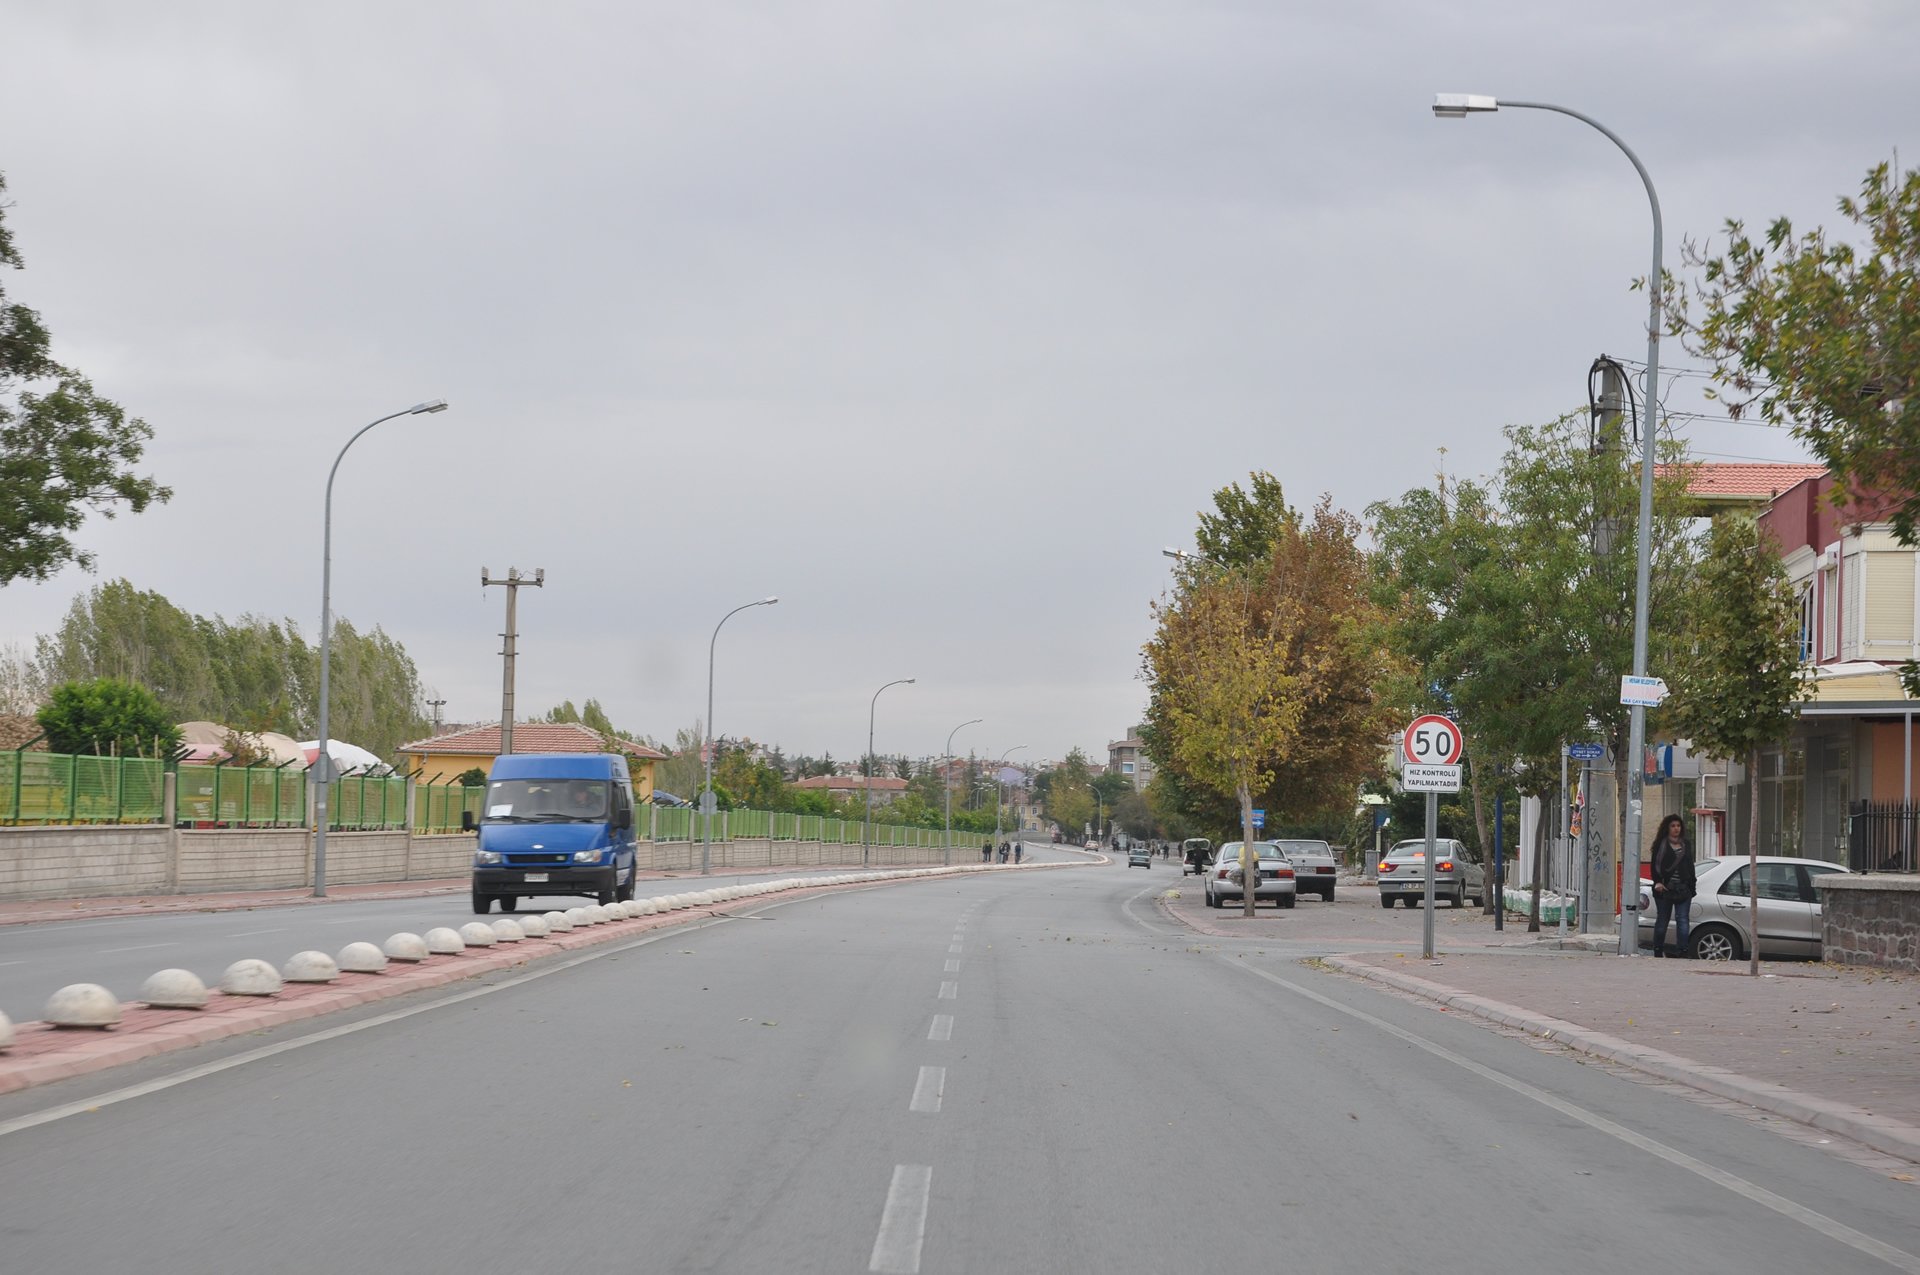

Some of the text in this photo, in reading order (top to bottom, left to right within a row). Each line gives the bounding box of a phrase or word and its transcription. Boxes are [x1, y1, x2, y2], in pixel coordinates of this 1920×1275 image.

[1416, 730, 1451, 757] 50
[1422, 769, 1457, 777] KONTROLÜ
[1407, 779, 1458, 788] YAPILMAKTADIR
